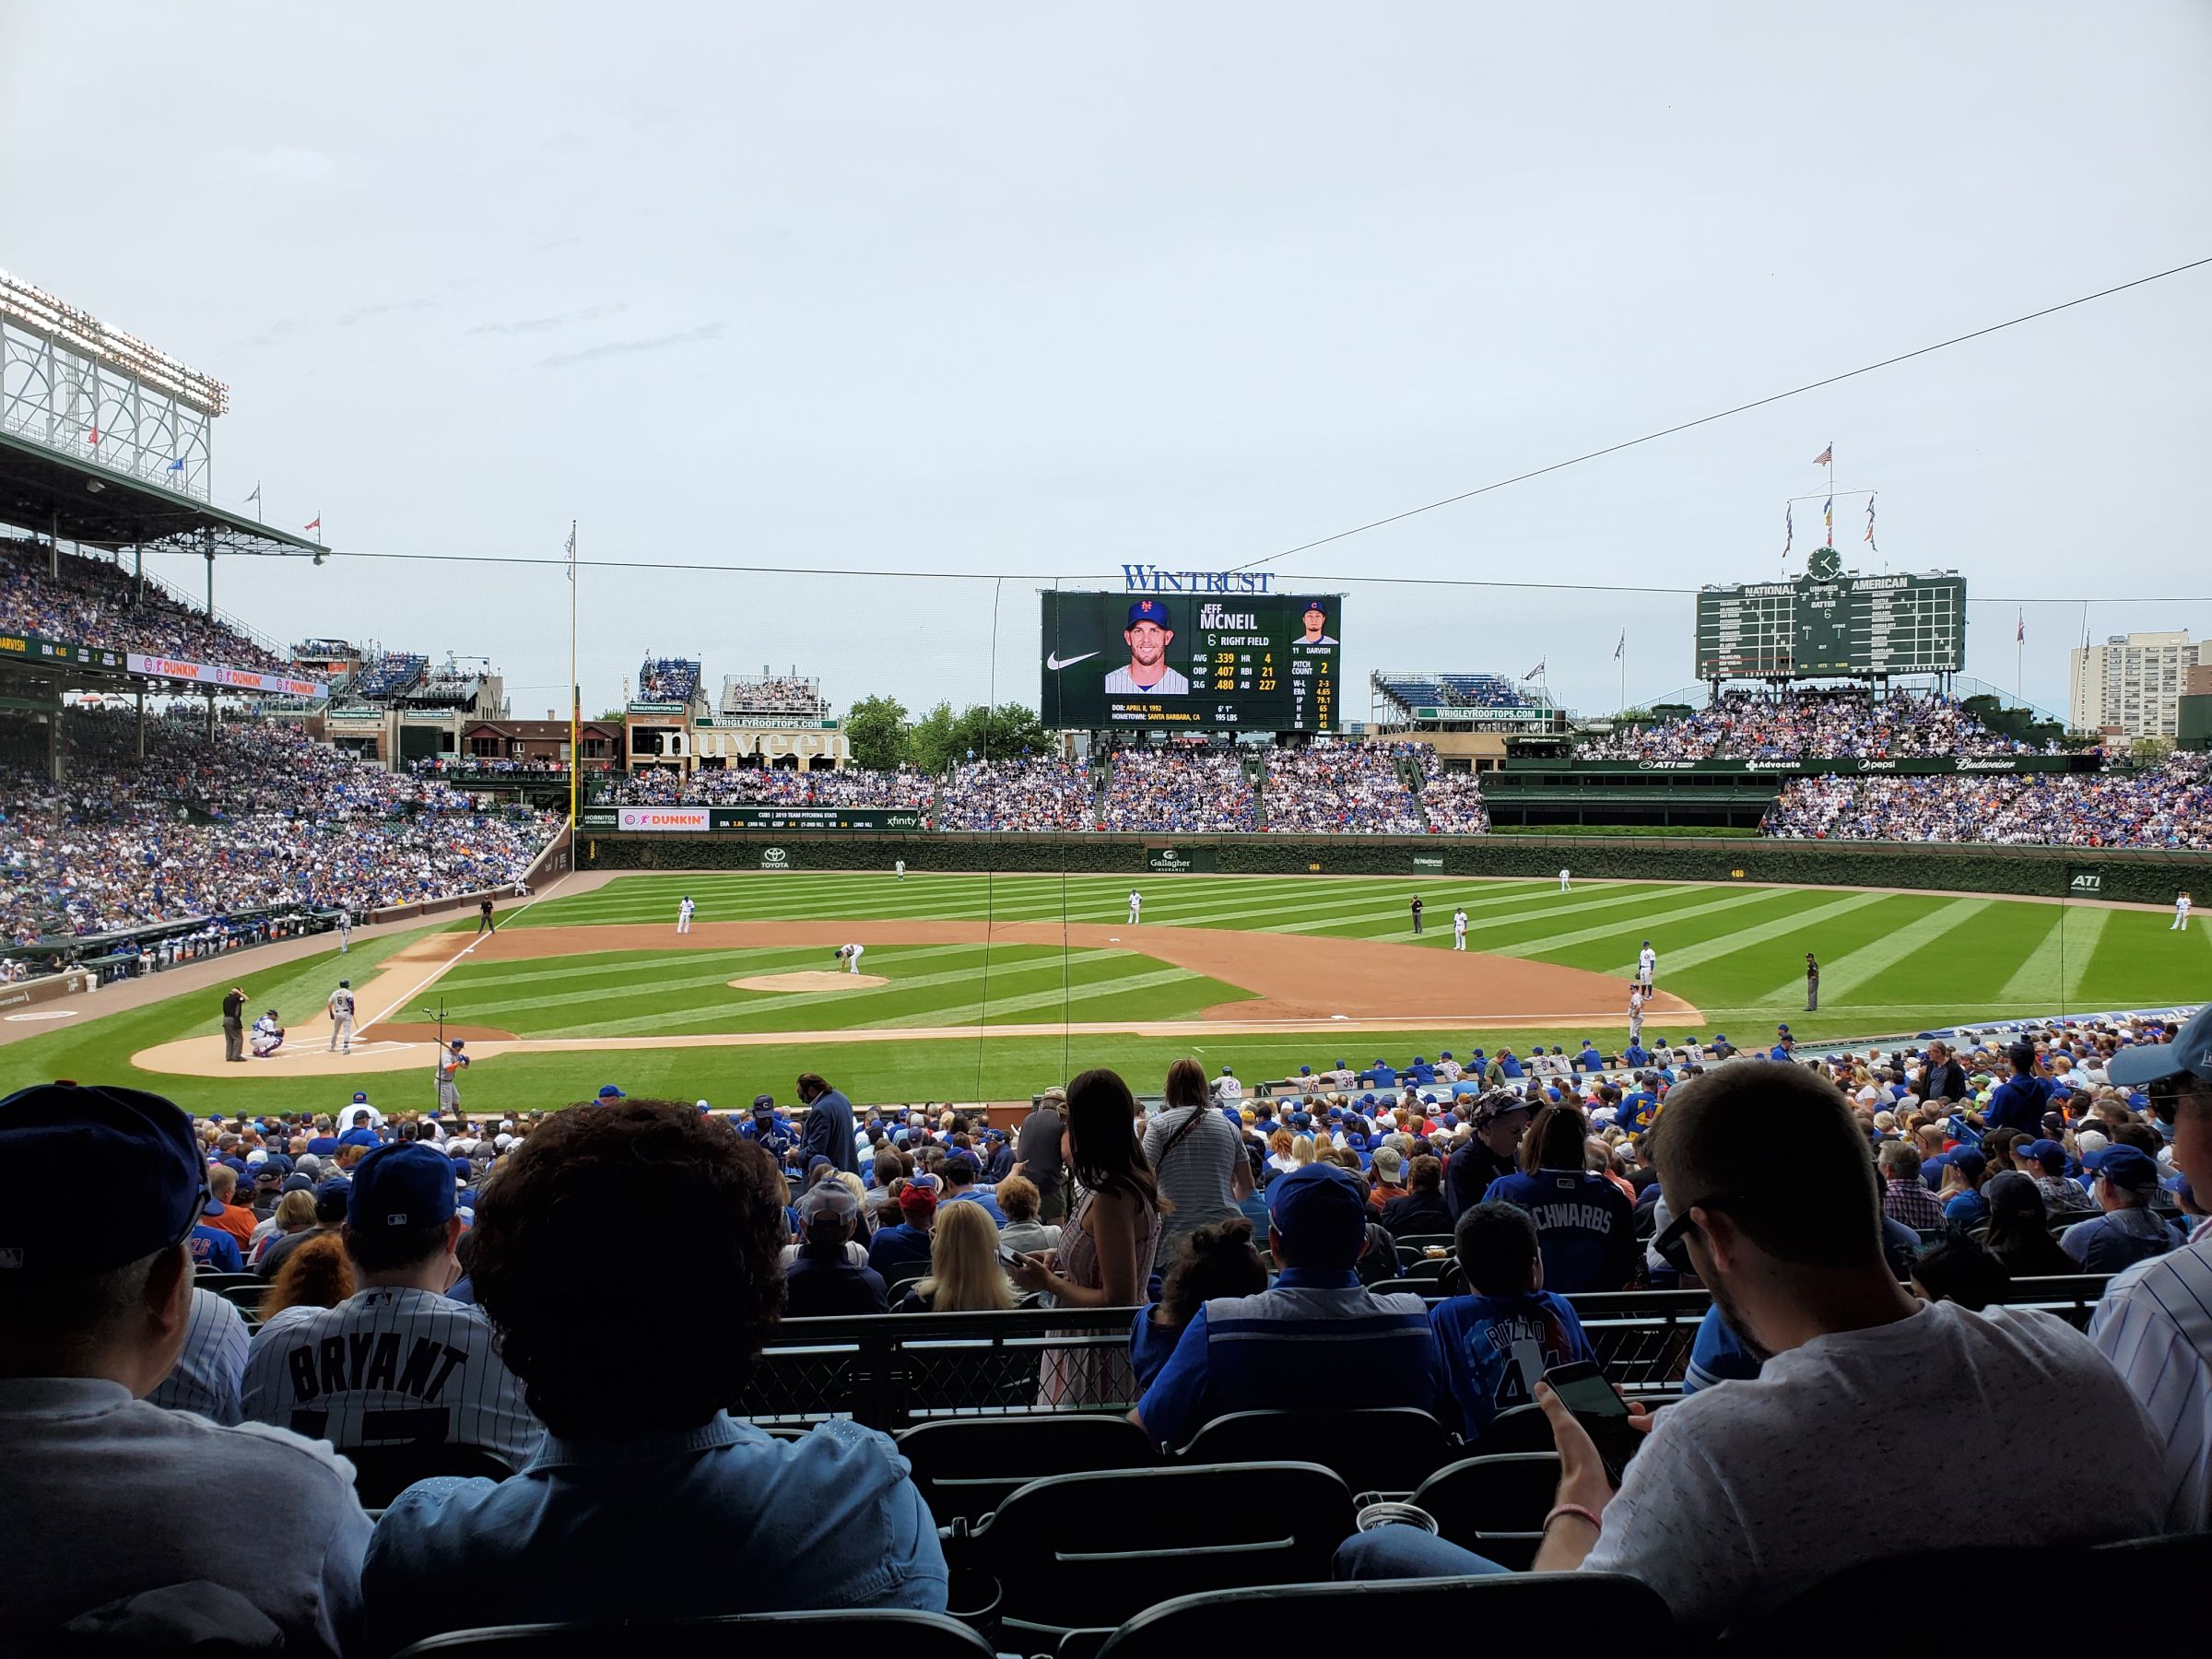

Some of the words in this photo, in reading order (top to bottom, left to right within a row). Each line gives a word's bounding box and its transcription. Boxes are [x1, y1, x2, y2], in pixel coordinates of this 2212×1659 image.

[1121, 564, 1275, 594] WINTRUST
[1852, 578, 1907, 590] AMERICAN
[1745, 585, 1796, 597] NATIONAL
[1200, 604, 1222, 614] JEFF
[1824, 609, 1831, 618] 6
[1200, 614, 1258, 629] MCNEIL
[1207, 634, 1216, 646] 6
[1220, 637, 1246, 646] RIGHT
[1247, 637, 1269, 646] FIELD
[42, 644, 53, 656] ERA
[1215, 653, 1235, 664] .339
[1265, 653, 1271, 664] 4
[164, 661, 199, 678] DUNKIN'
[1214, 666, 1234, 677] .407
[1262, 667, 1273, 677] 21
[1321, 663, 1328, 674] 2
[233, 671, 262, 687] DUNKIN'
[1214, 680, 1234, 690] .480
[1240, 681, 1250, 689] AB
[1259, 680, 1276, 690] 227
[290, 680, 316, 694] DUNKIN'
[1436, 709, 1535, 719] WRIGLEYROOFTOPS.COM
[712, 720, 822, 728] WRIGLEYROOFTOPS.COM
[659, 732, 853, 759] nuveen
[1871, 761, 1896, 769] pepsi
[1955, 758, 2016, 770] Budweiser
[652, 816, 704, 825] DUNKIN'
[887, 816, 917, 826] xfinity
[1150, 859, 1191, 868] Gallagher
[2071, 875, 2100, 887] ATI
[1228, 1081, 1239, 1091] 24
[1343, 1077, 1354, 1087] 36
[1533, 1203, 1612, 1234] CHWARBS
[1484, 1317, 1544, 1350] RIZZO
[289, 1333, 469, 1403] BRYANT
